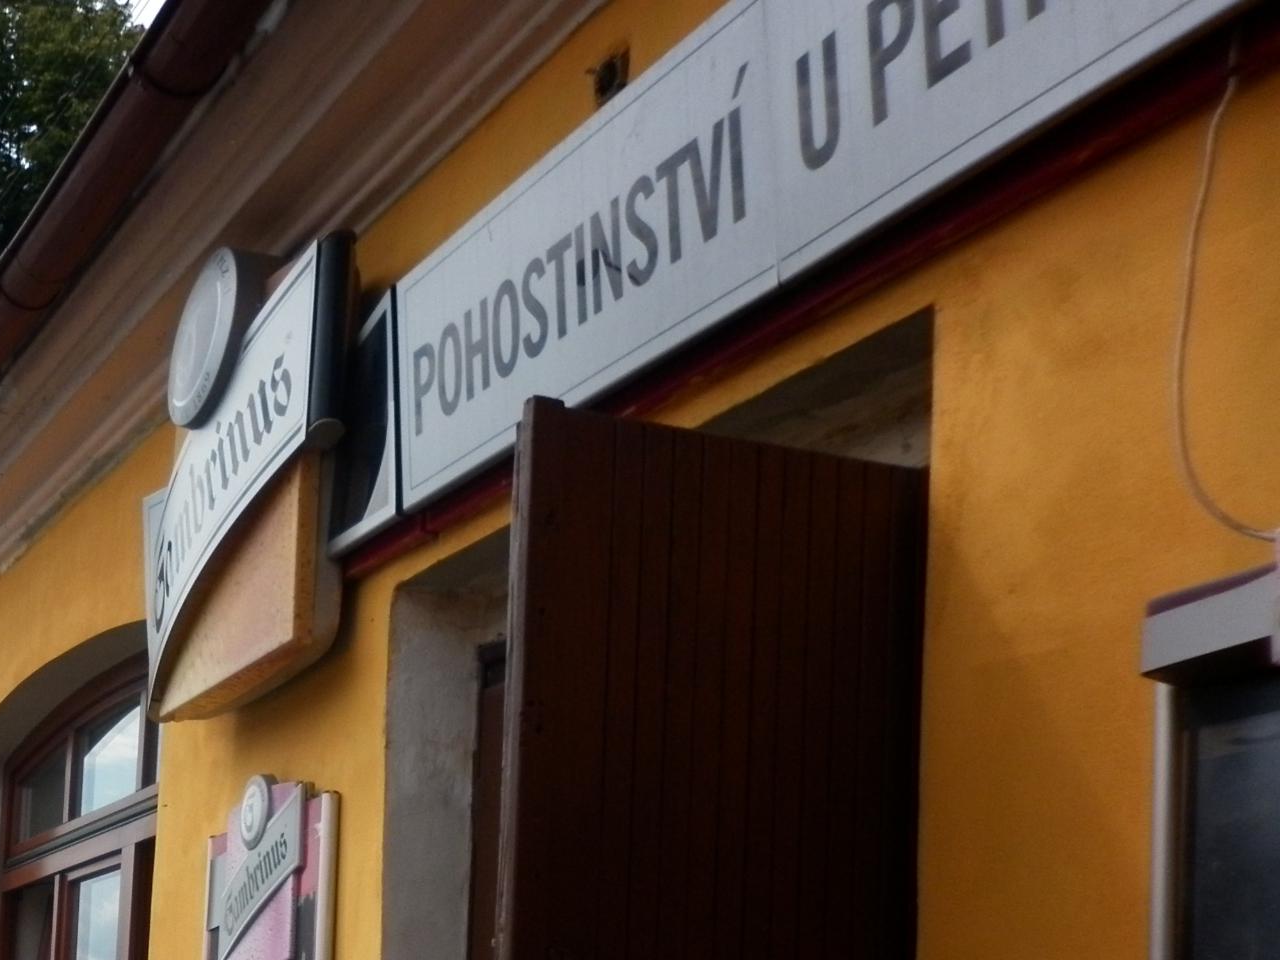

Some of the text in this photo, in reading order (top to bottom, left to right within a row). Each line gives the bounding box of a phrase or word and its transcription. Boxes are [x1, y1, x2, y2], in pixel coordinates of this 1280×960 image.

[413, 63, 748, 435] POHOSTINSTVÍ
[796, 30, 840, 170] U
[154, 352, 292, 633] Gambrinus
[224, 832, 289, 936] Gambrinus
